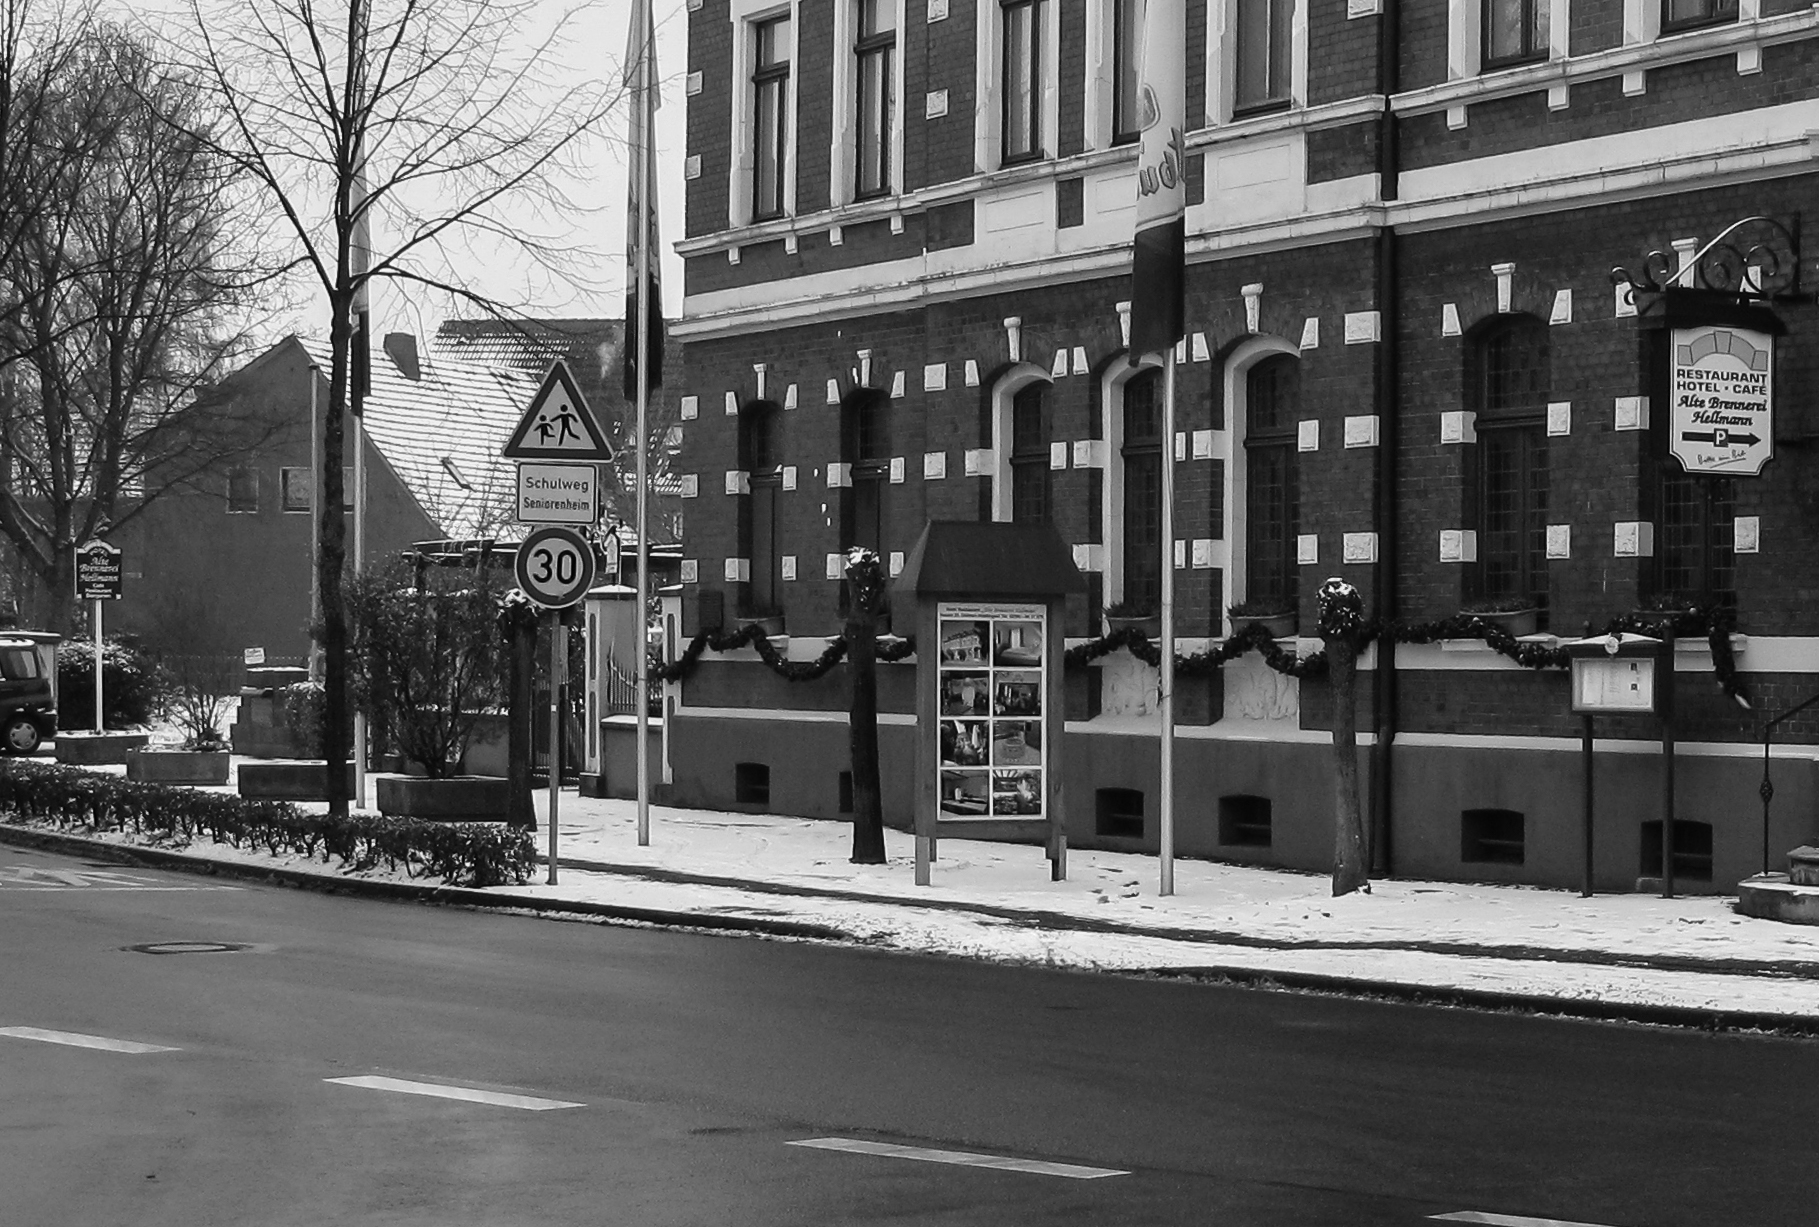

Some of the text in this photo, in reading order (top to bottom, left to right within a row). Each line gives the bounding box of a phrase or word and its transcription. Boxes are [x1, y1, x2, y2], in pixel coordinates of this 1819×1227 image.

[1677, 368, 1767, 385] RESTAURANT
[1677, 380, 1720, 392] HOTEL
[1677, 394, 1767, 411] Alte Brennerei
[1691, 410, 1753, 426] Hellmann
[1715, 430, 1727, 445] P
[525, 476, 589, 493] Schulweg
[523, 497, 590, 511] Seniorenheim
[533, 548, 577, 585] 30
